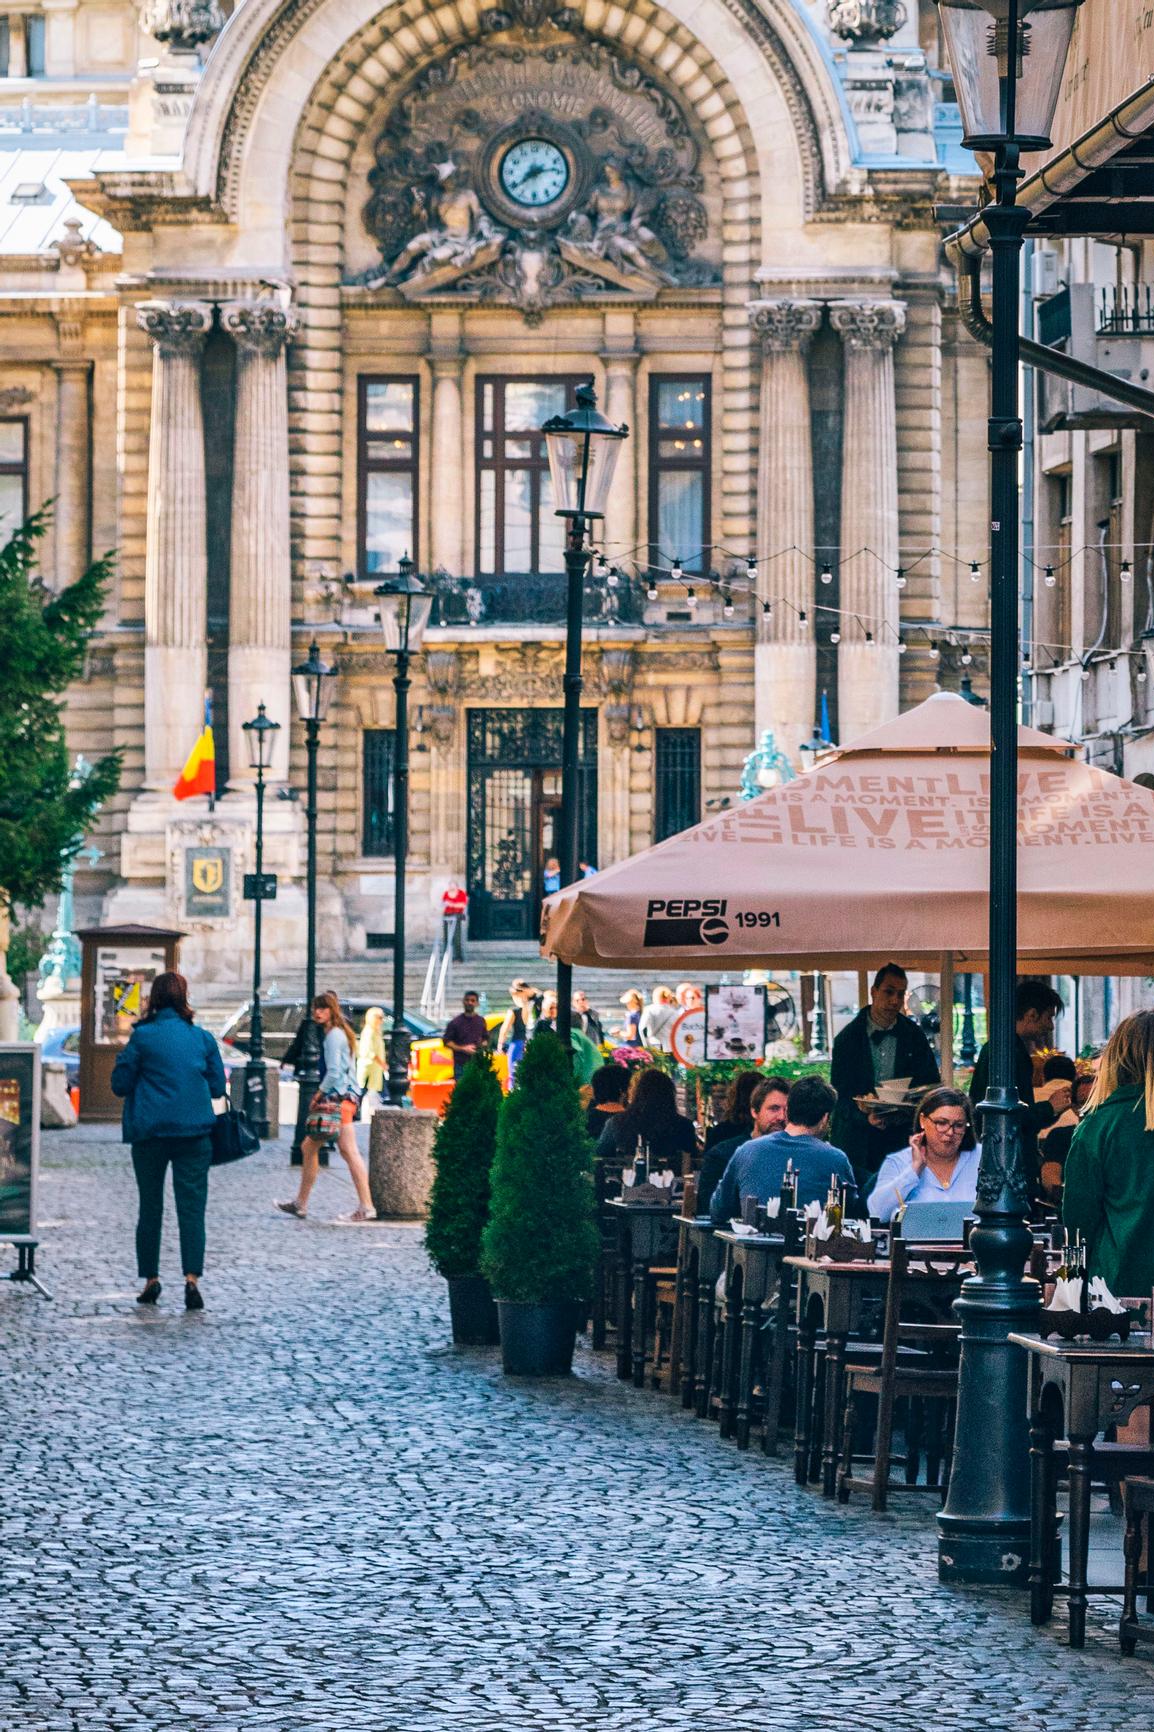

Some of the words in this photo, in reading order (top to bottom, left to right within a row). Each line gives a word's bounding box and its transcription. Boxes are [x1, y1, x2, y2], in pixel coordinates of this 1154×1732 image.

[787, 804, 950, 838] LIVE
[790, 833, 857, 848] LIFE
[865, 836, 897, 849] IS
[903, 836, 928, 850] A
[647, 900, 727, 917] PEPSI
[735, 912, 780, 928] 1991
